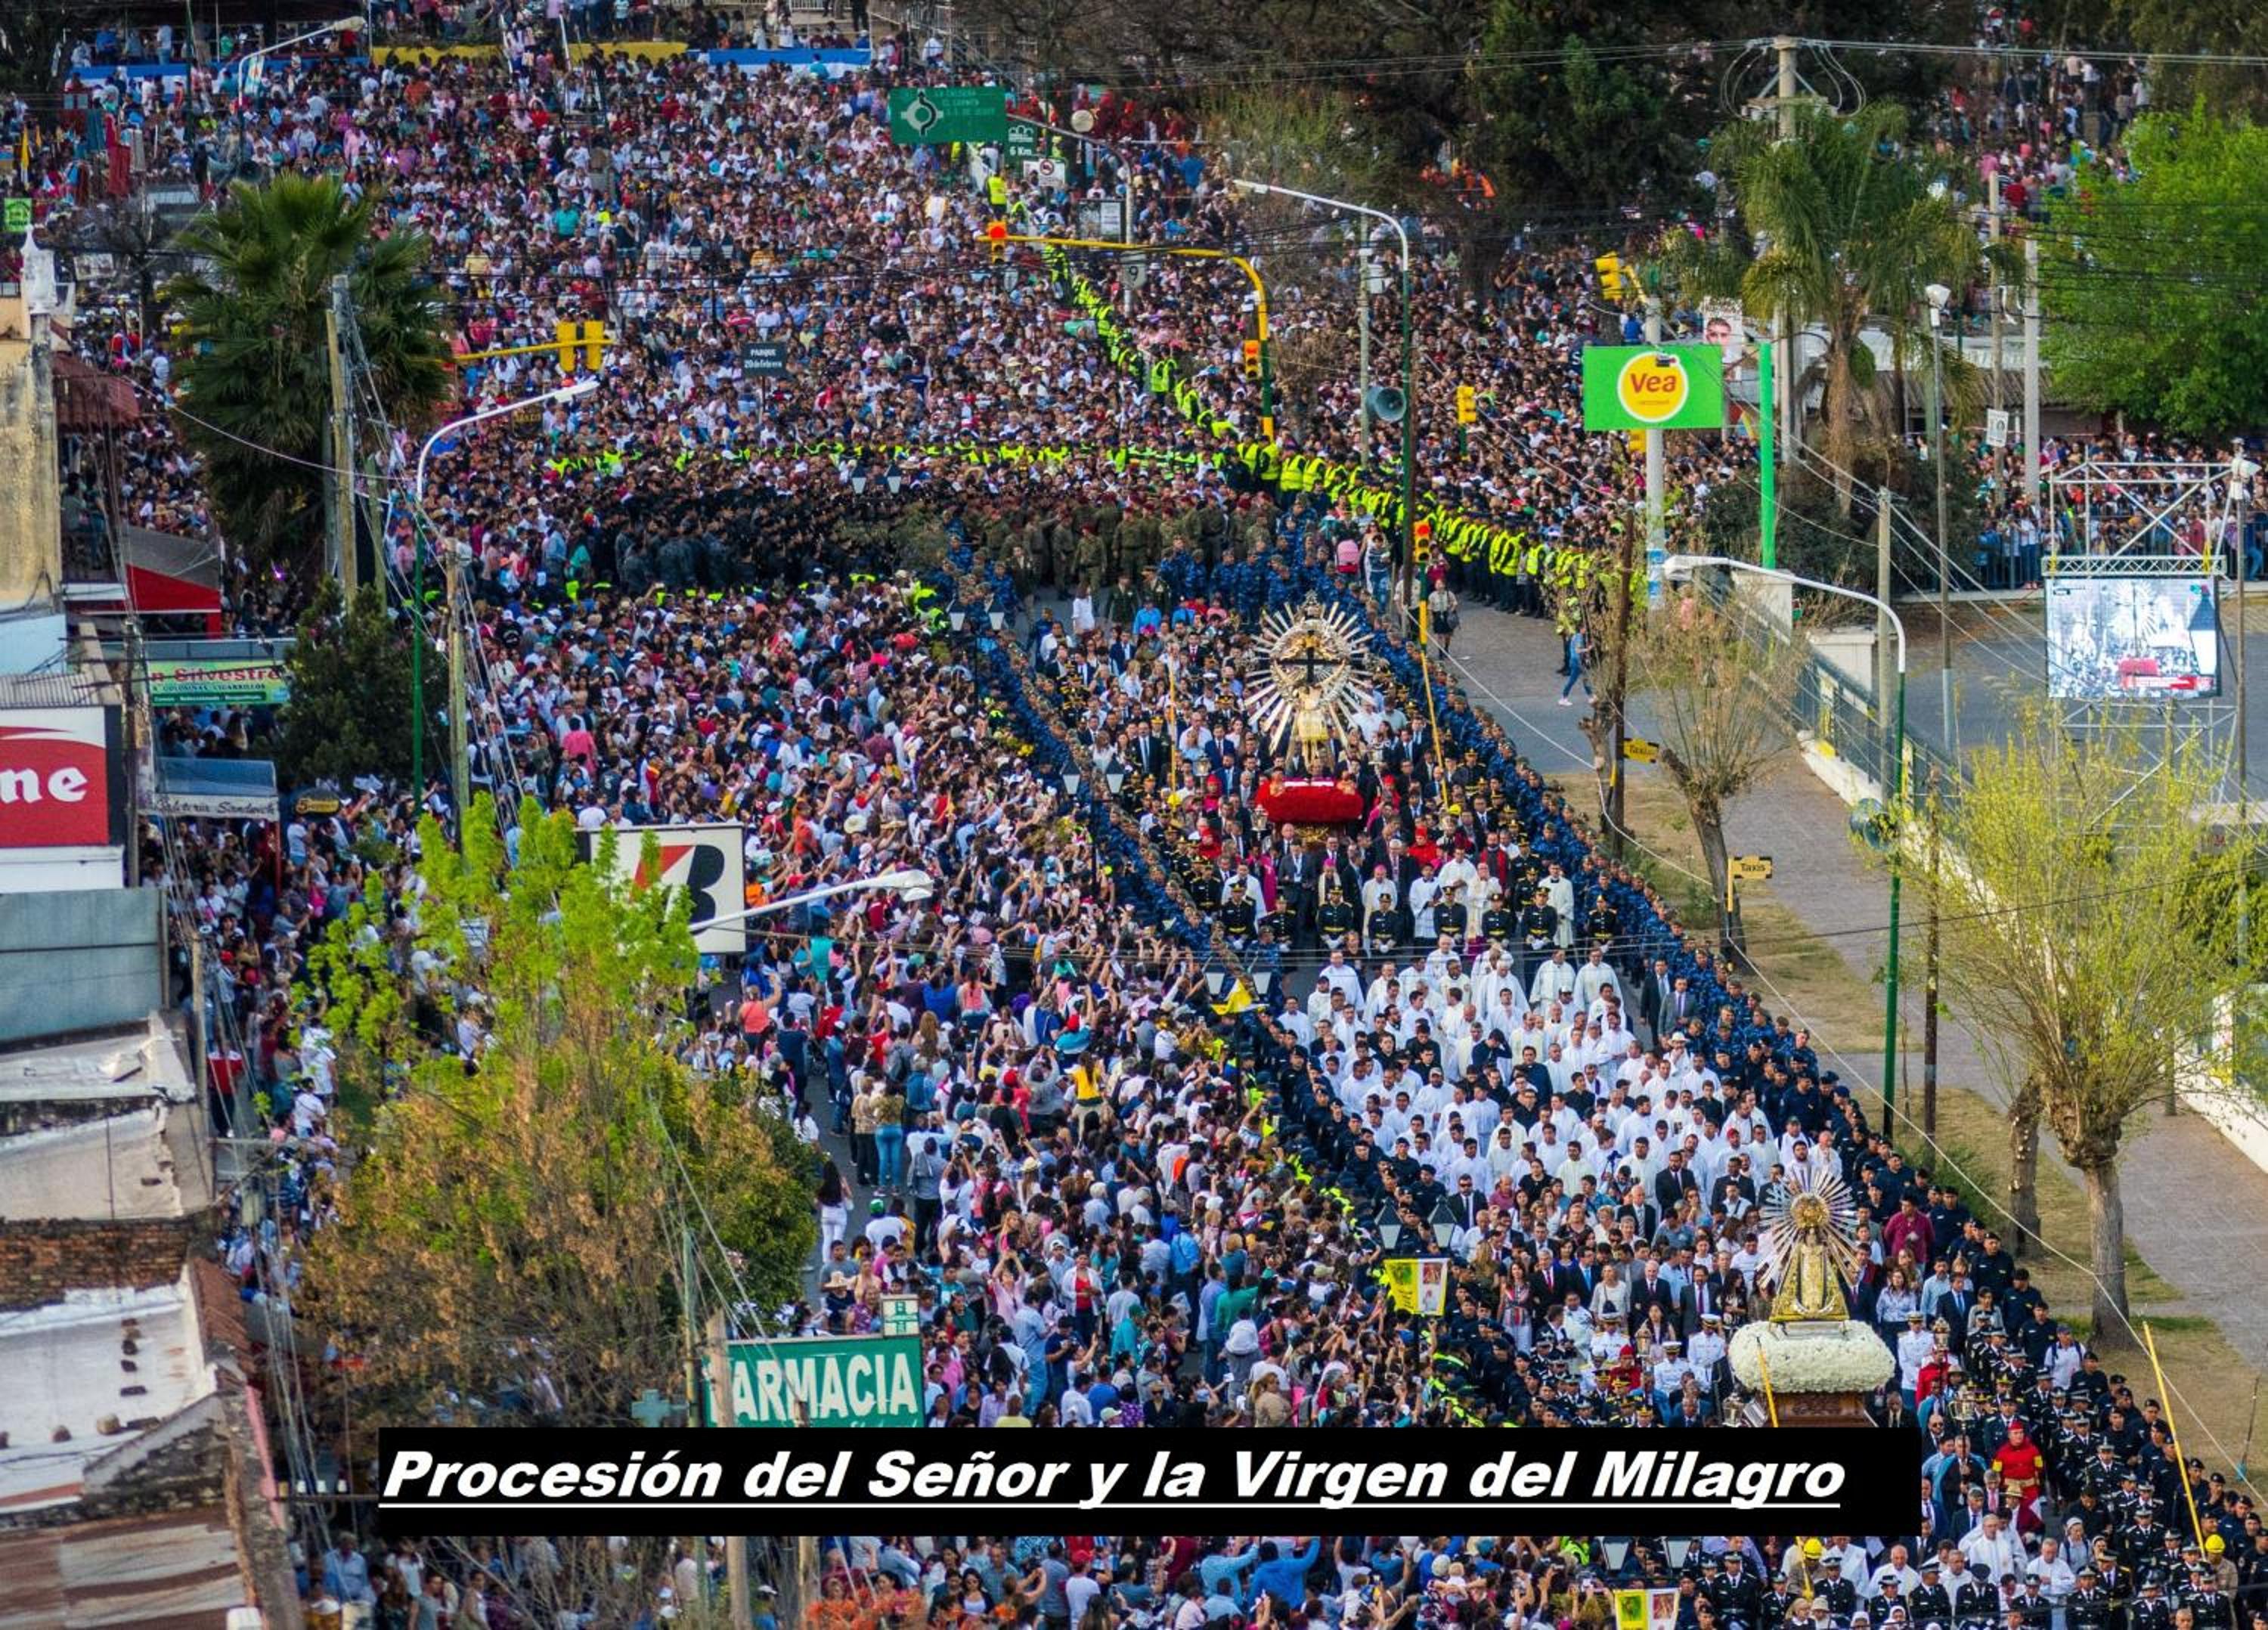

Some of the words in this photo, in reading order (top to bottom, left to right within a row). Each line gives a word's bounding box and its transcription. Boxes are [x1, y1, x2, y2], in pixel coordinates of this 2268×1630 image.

[1009, 146, 1017, 156] 6
[750, 349, 776, 357] PARQUE
[1630, 373, 1677, 394] Vea
[1740, 863, 1766, 872] Taxis
